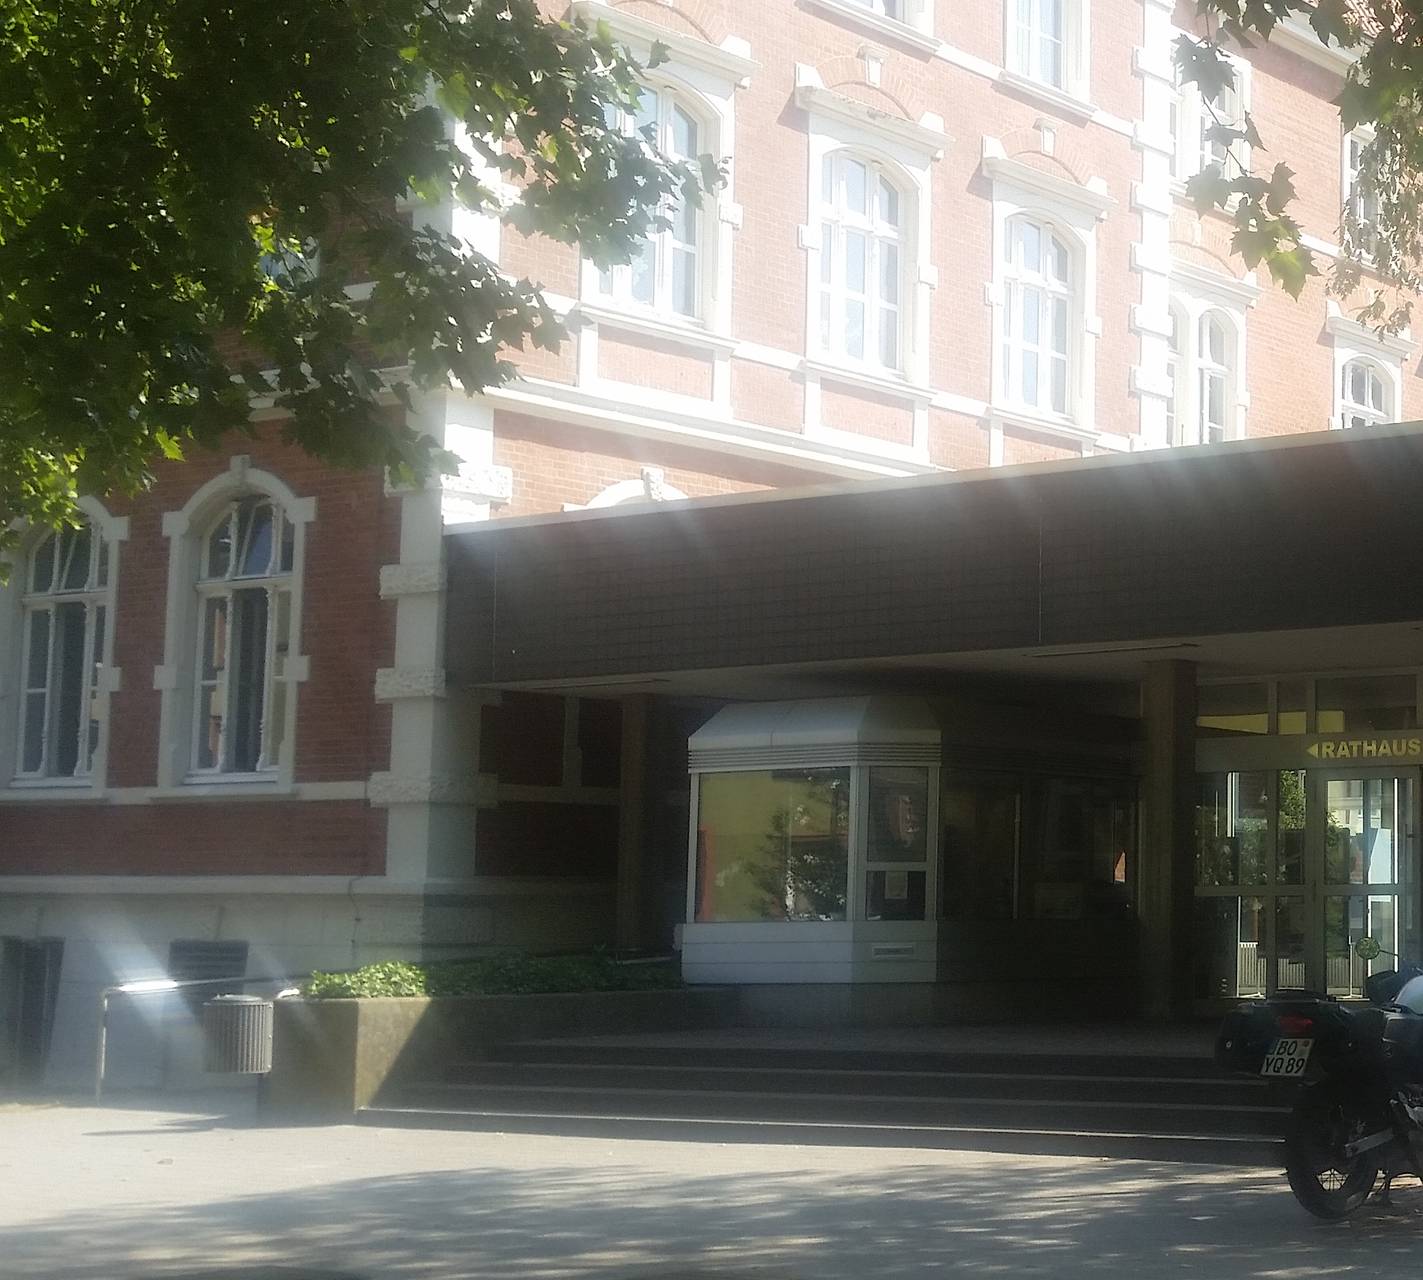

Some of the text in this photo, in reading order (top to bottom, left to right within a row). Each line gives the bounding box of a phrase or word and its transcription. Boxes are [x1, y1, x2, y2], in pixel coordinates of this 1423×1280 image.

[1321, 737, 1421, 759] RATHAUS
[1276, 1040, 1298, 1056] BO
[1265, 1057, 1305, 1074] YQ 89
